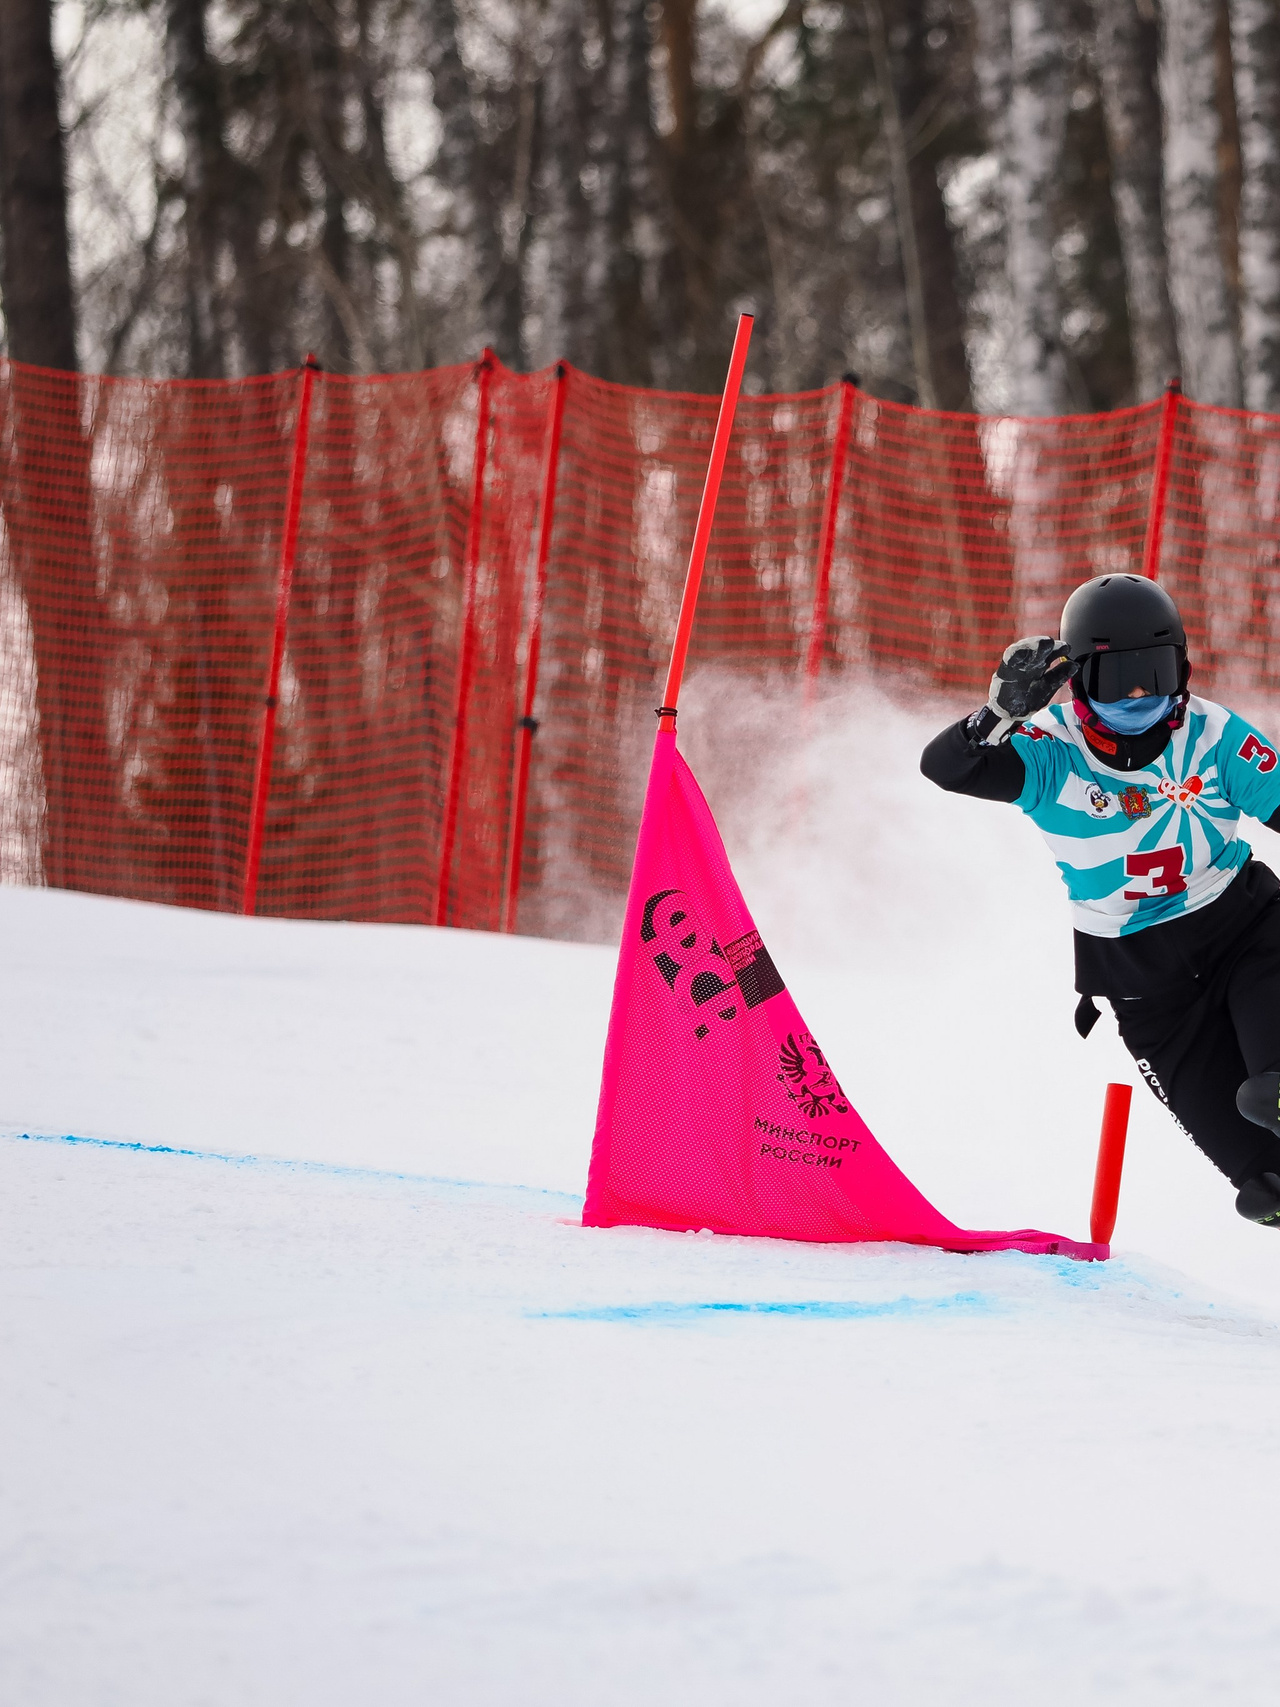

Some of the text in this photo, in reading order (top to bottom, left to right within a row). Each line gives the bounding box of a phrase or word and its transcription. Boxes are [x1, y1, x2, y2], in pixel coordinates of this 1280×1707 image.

[1236, 732, 1279, 774] 3
[1123, 843, 1189, 901] 3
[754, 1116, 862, 1152] МИНСПОРТ
[760, 1143, 843, 1169] РОССИИ
